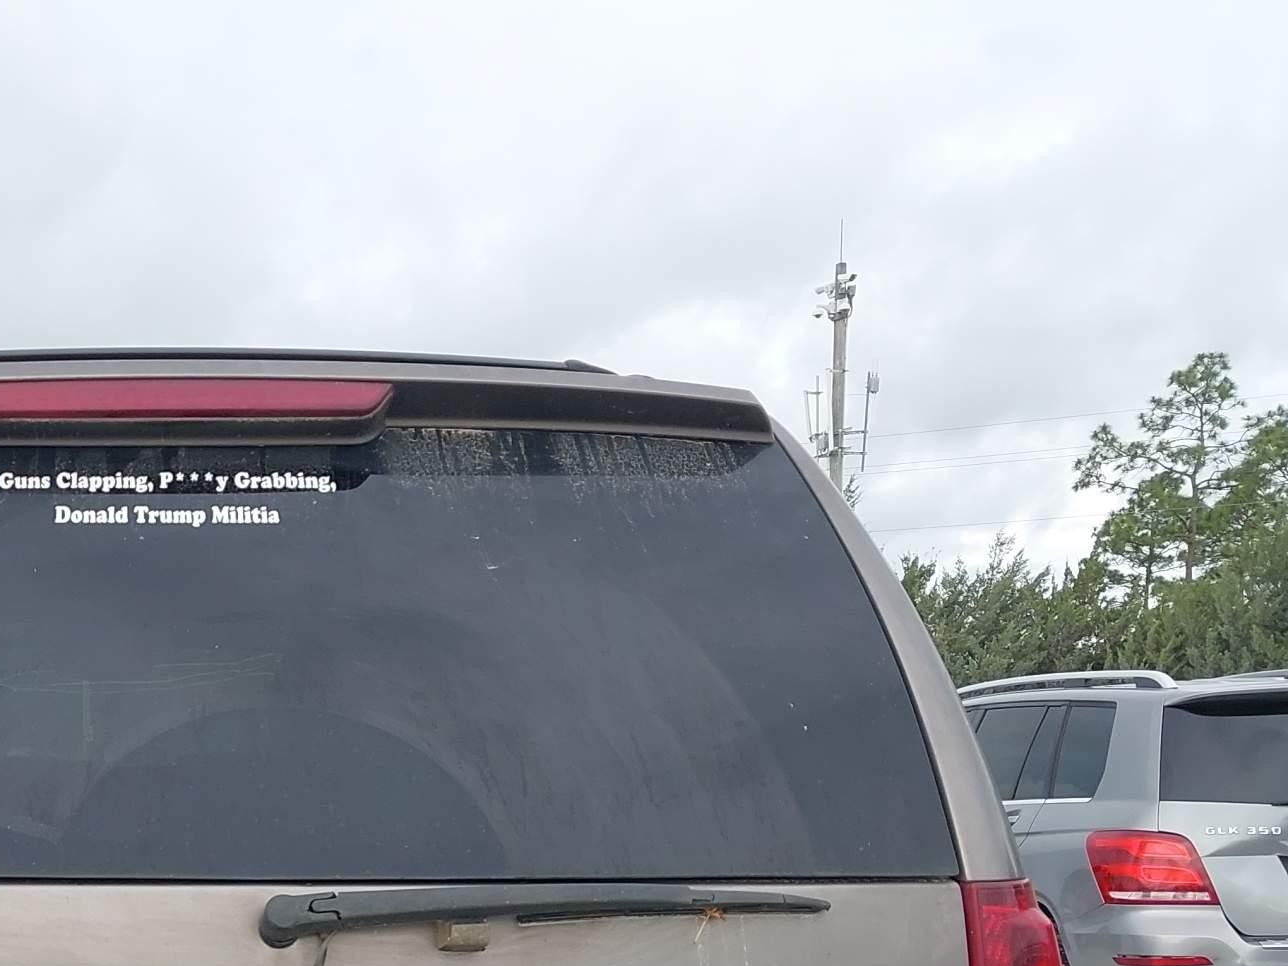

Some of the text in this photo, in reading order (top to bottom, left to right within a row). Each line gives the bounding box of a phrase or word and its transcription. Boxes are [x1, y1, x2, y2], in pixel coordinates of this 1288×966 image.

[55, 471, 154, 493] Clapping,
[234, 471, 337, 493] Grabbing,
[54, 505, 281, 528] Donald Trump Militia
[1205, 826, 1282, 835] GLK 350
